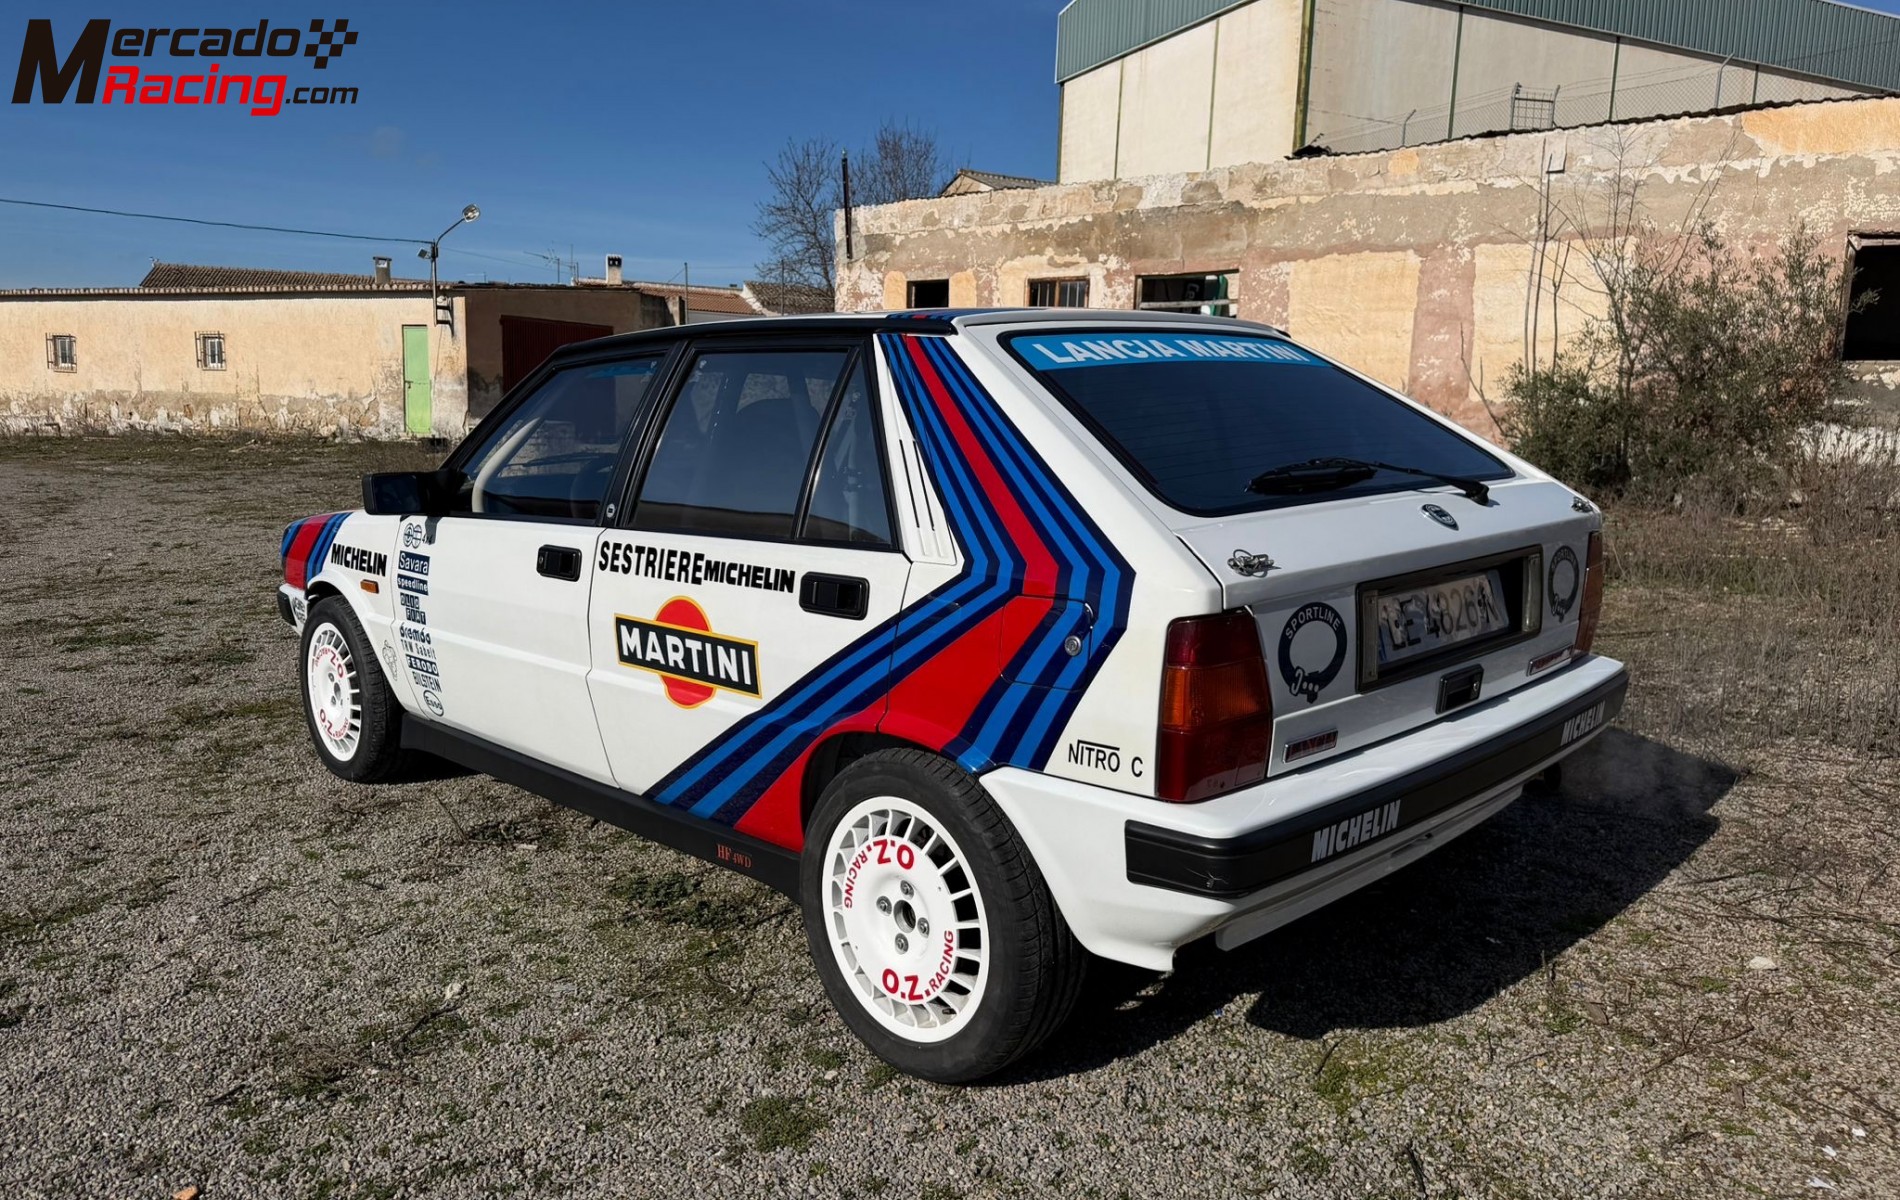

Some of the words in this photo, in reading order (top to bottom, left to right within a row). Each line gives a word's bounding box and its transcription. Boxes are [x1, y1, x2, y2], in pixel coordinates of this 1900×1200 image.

[1031, 339, 1188, 363] LANCIA
[1174, 339, 1310, 362] MARTINI
[331, 543, 387, 577] MICHELIN
[400, 552, 428, 574] Savara
[599, 540, 705, 585] SESTRIERE
[703, 559, 796, 593] MICHELIN
[397, 577, 428, 592] speedline
[400, 622, 431, 645] brembo
[1285, 606, 1341, 639] SPORTLINE
[406, 656, 438, 677] FERODO
[620, 624, 752, 686] MARTINI
[1560, 700, 1605, 746] MICHELIN
[1068, 739, 1120, 773] NITRO
[1131, 756, 1143, 777] C
[1311, 798, 1401, 863] MICHELIN
